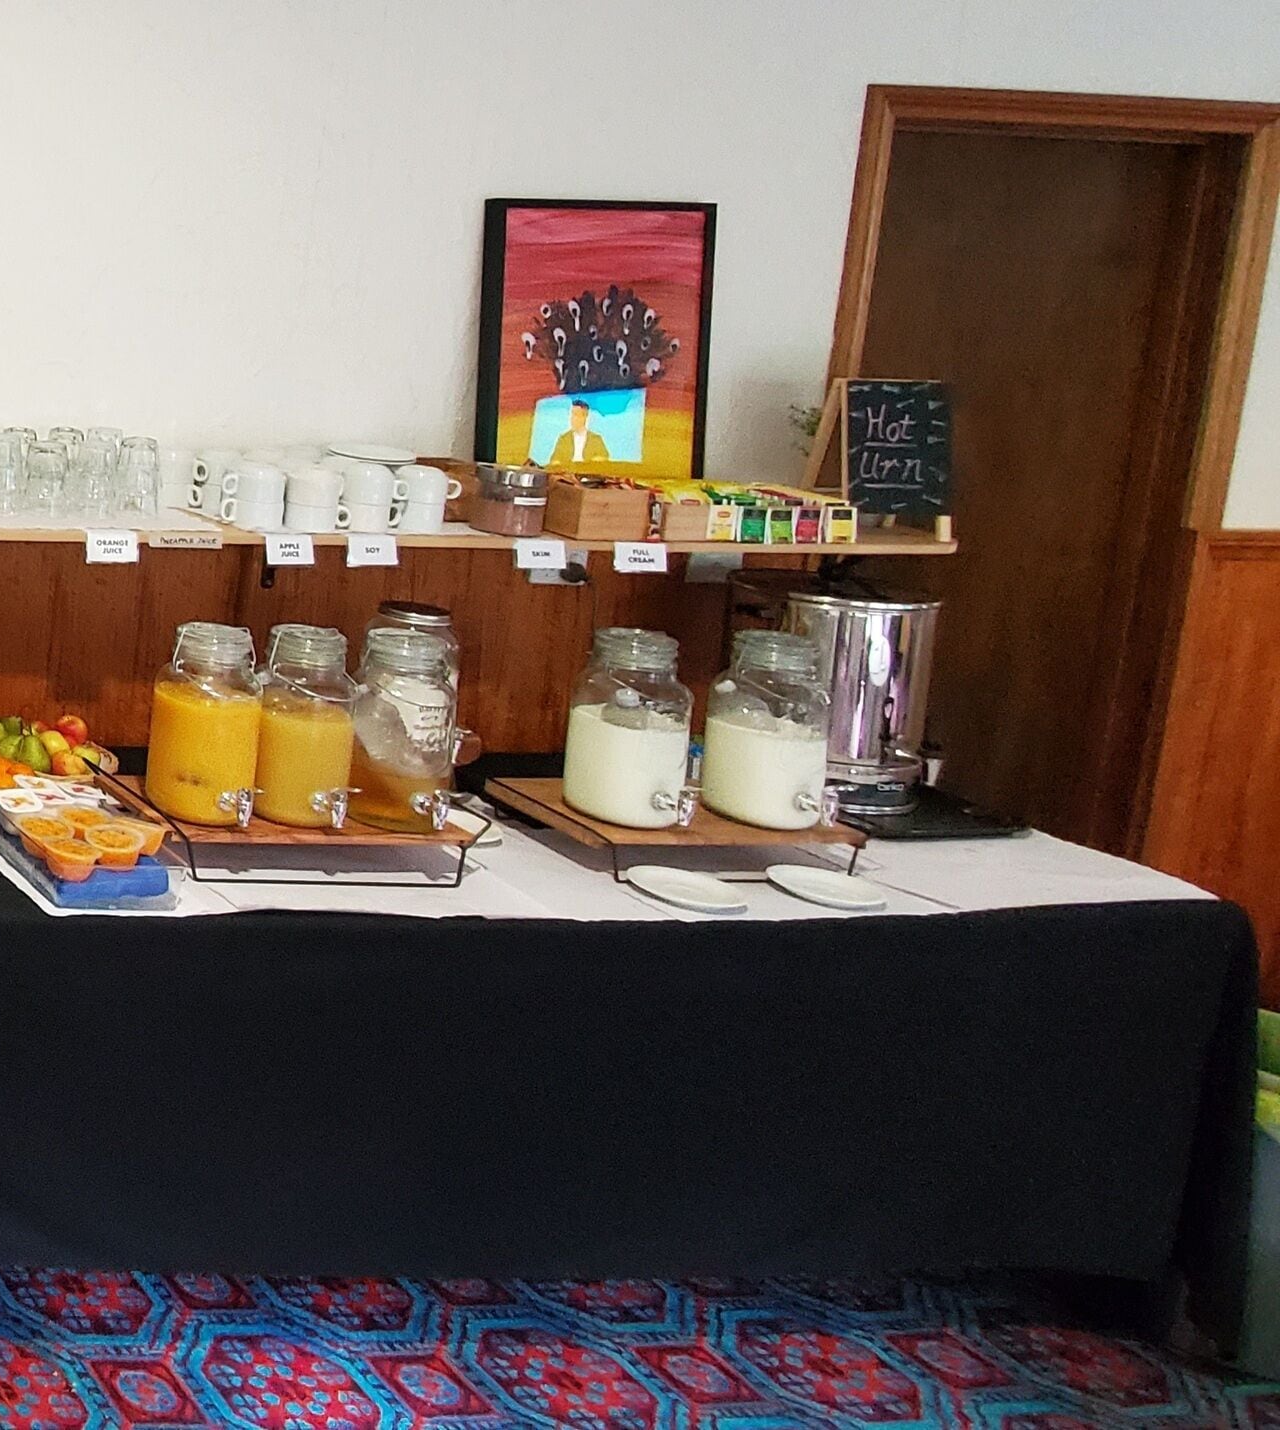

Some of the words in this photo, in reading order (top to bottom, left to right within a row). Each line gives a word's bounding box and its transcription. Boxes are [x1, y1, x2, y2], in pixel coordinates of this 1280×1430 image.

[866, 404, 917, 442] Hot
[860, 452, 924, 482] Urn
[96, 539, 128, 547] ORANGE
